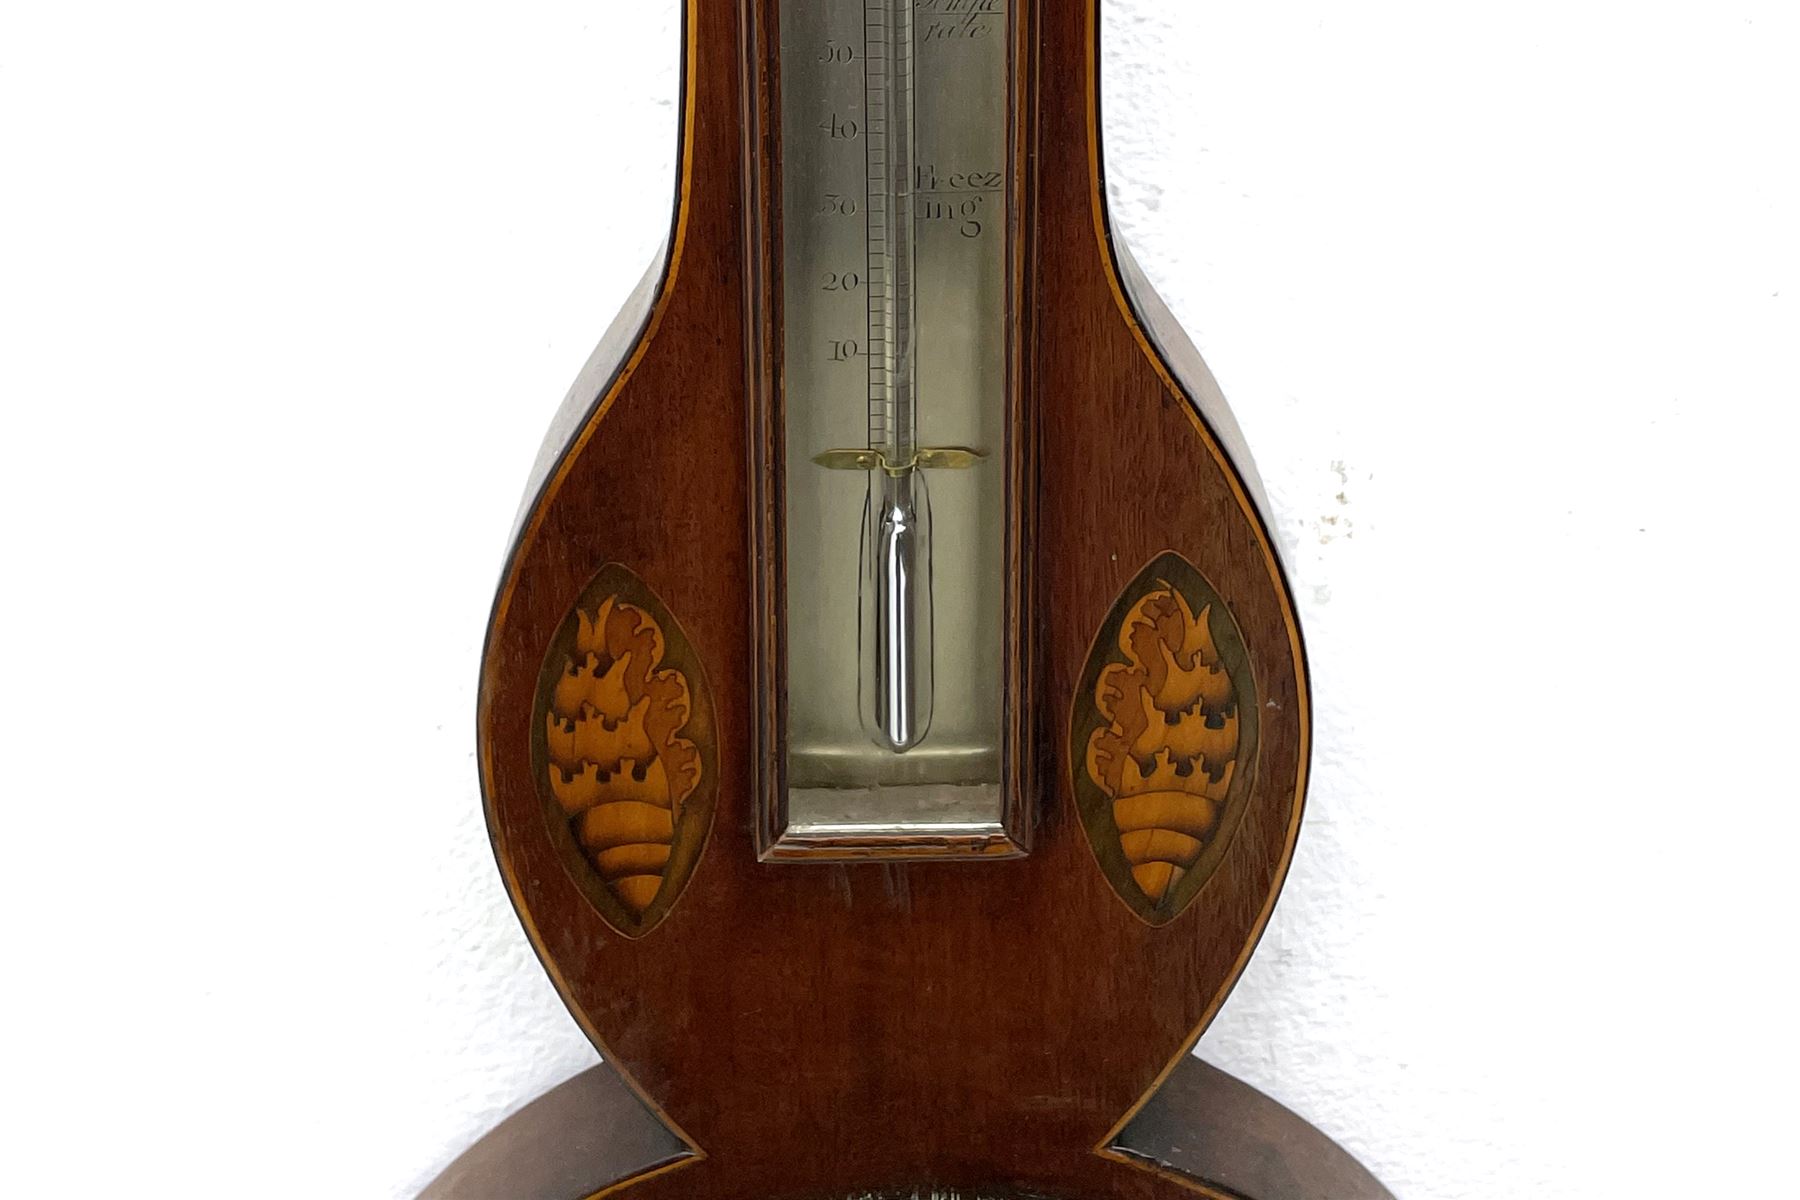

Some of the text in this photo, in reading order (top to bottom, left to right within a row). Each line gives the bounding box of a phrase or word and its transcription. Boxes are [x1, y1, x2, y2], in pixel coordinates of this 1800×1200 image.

[818, 39, 854, 65] 50
[818, 113, 858, 140] 40
[820, 194, 857, 217] 30
[821, 272, 859, 291] 20
[826, 339, 858, 362] 10
